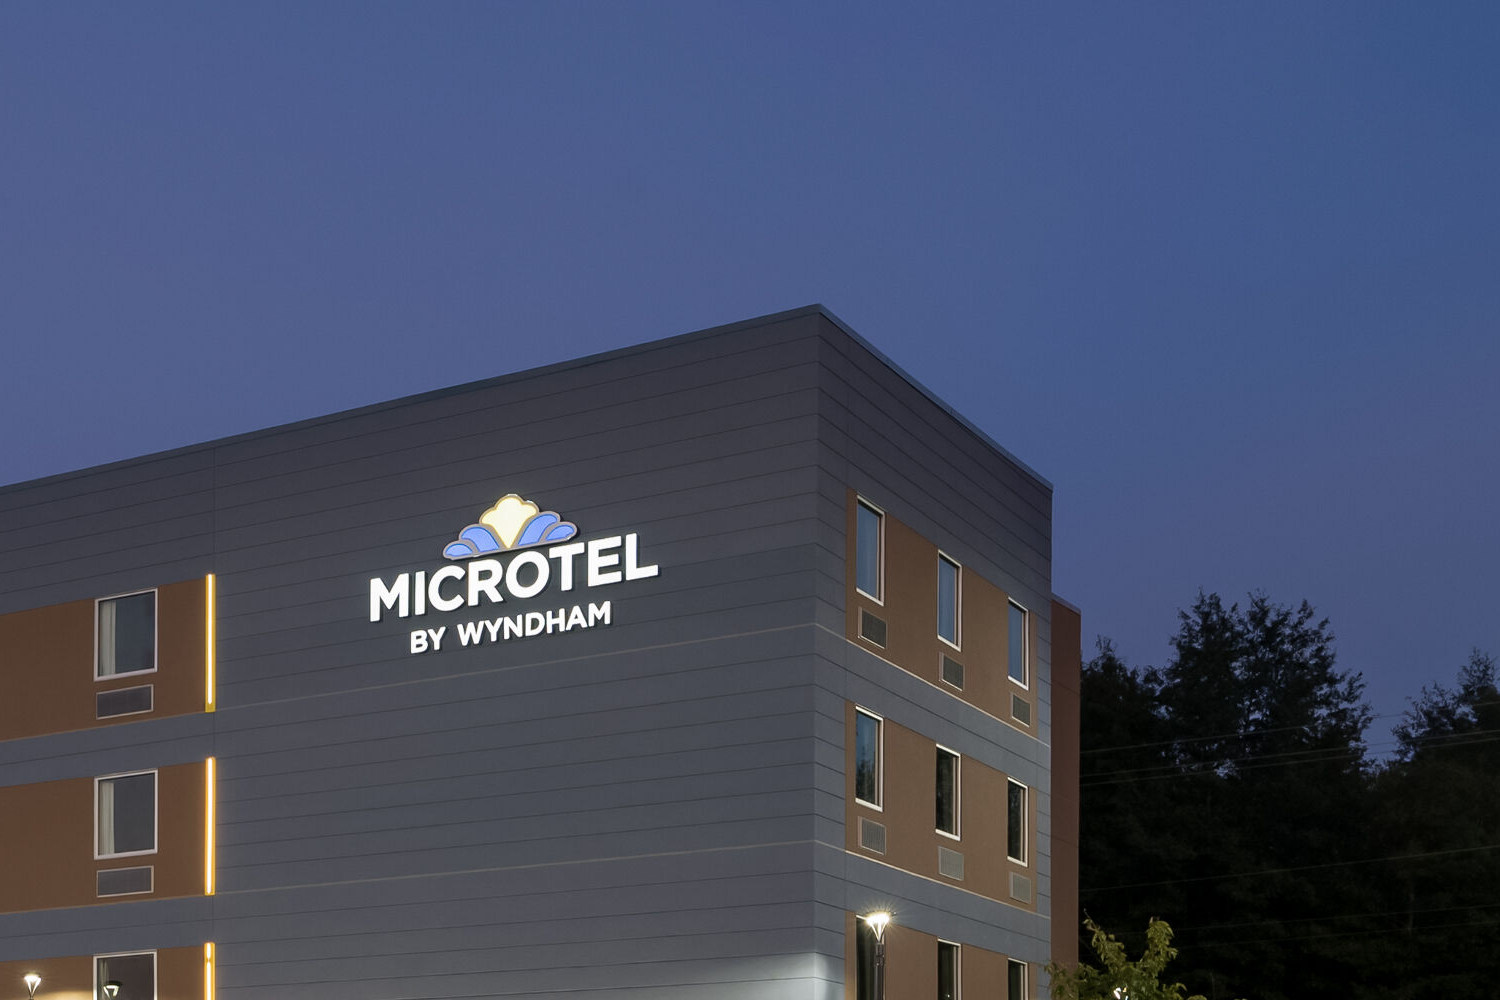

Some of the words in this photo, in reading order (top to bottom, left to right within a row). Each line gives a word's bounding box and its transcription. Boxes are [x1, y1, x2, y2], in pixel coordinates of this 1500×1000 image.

[369, 533, 659, 622] MICROTEL
[410, 626, 446, 654] BY
[457, 600, 612, 647] WYNDHAM
